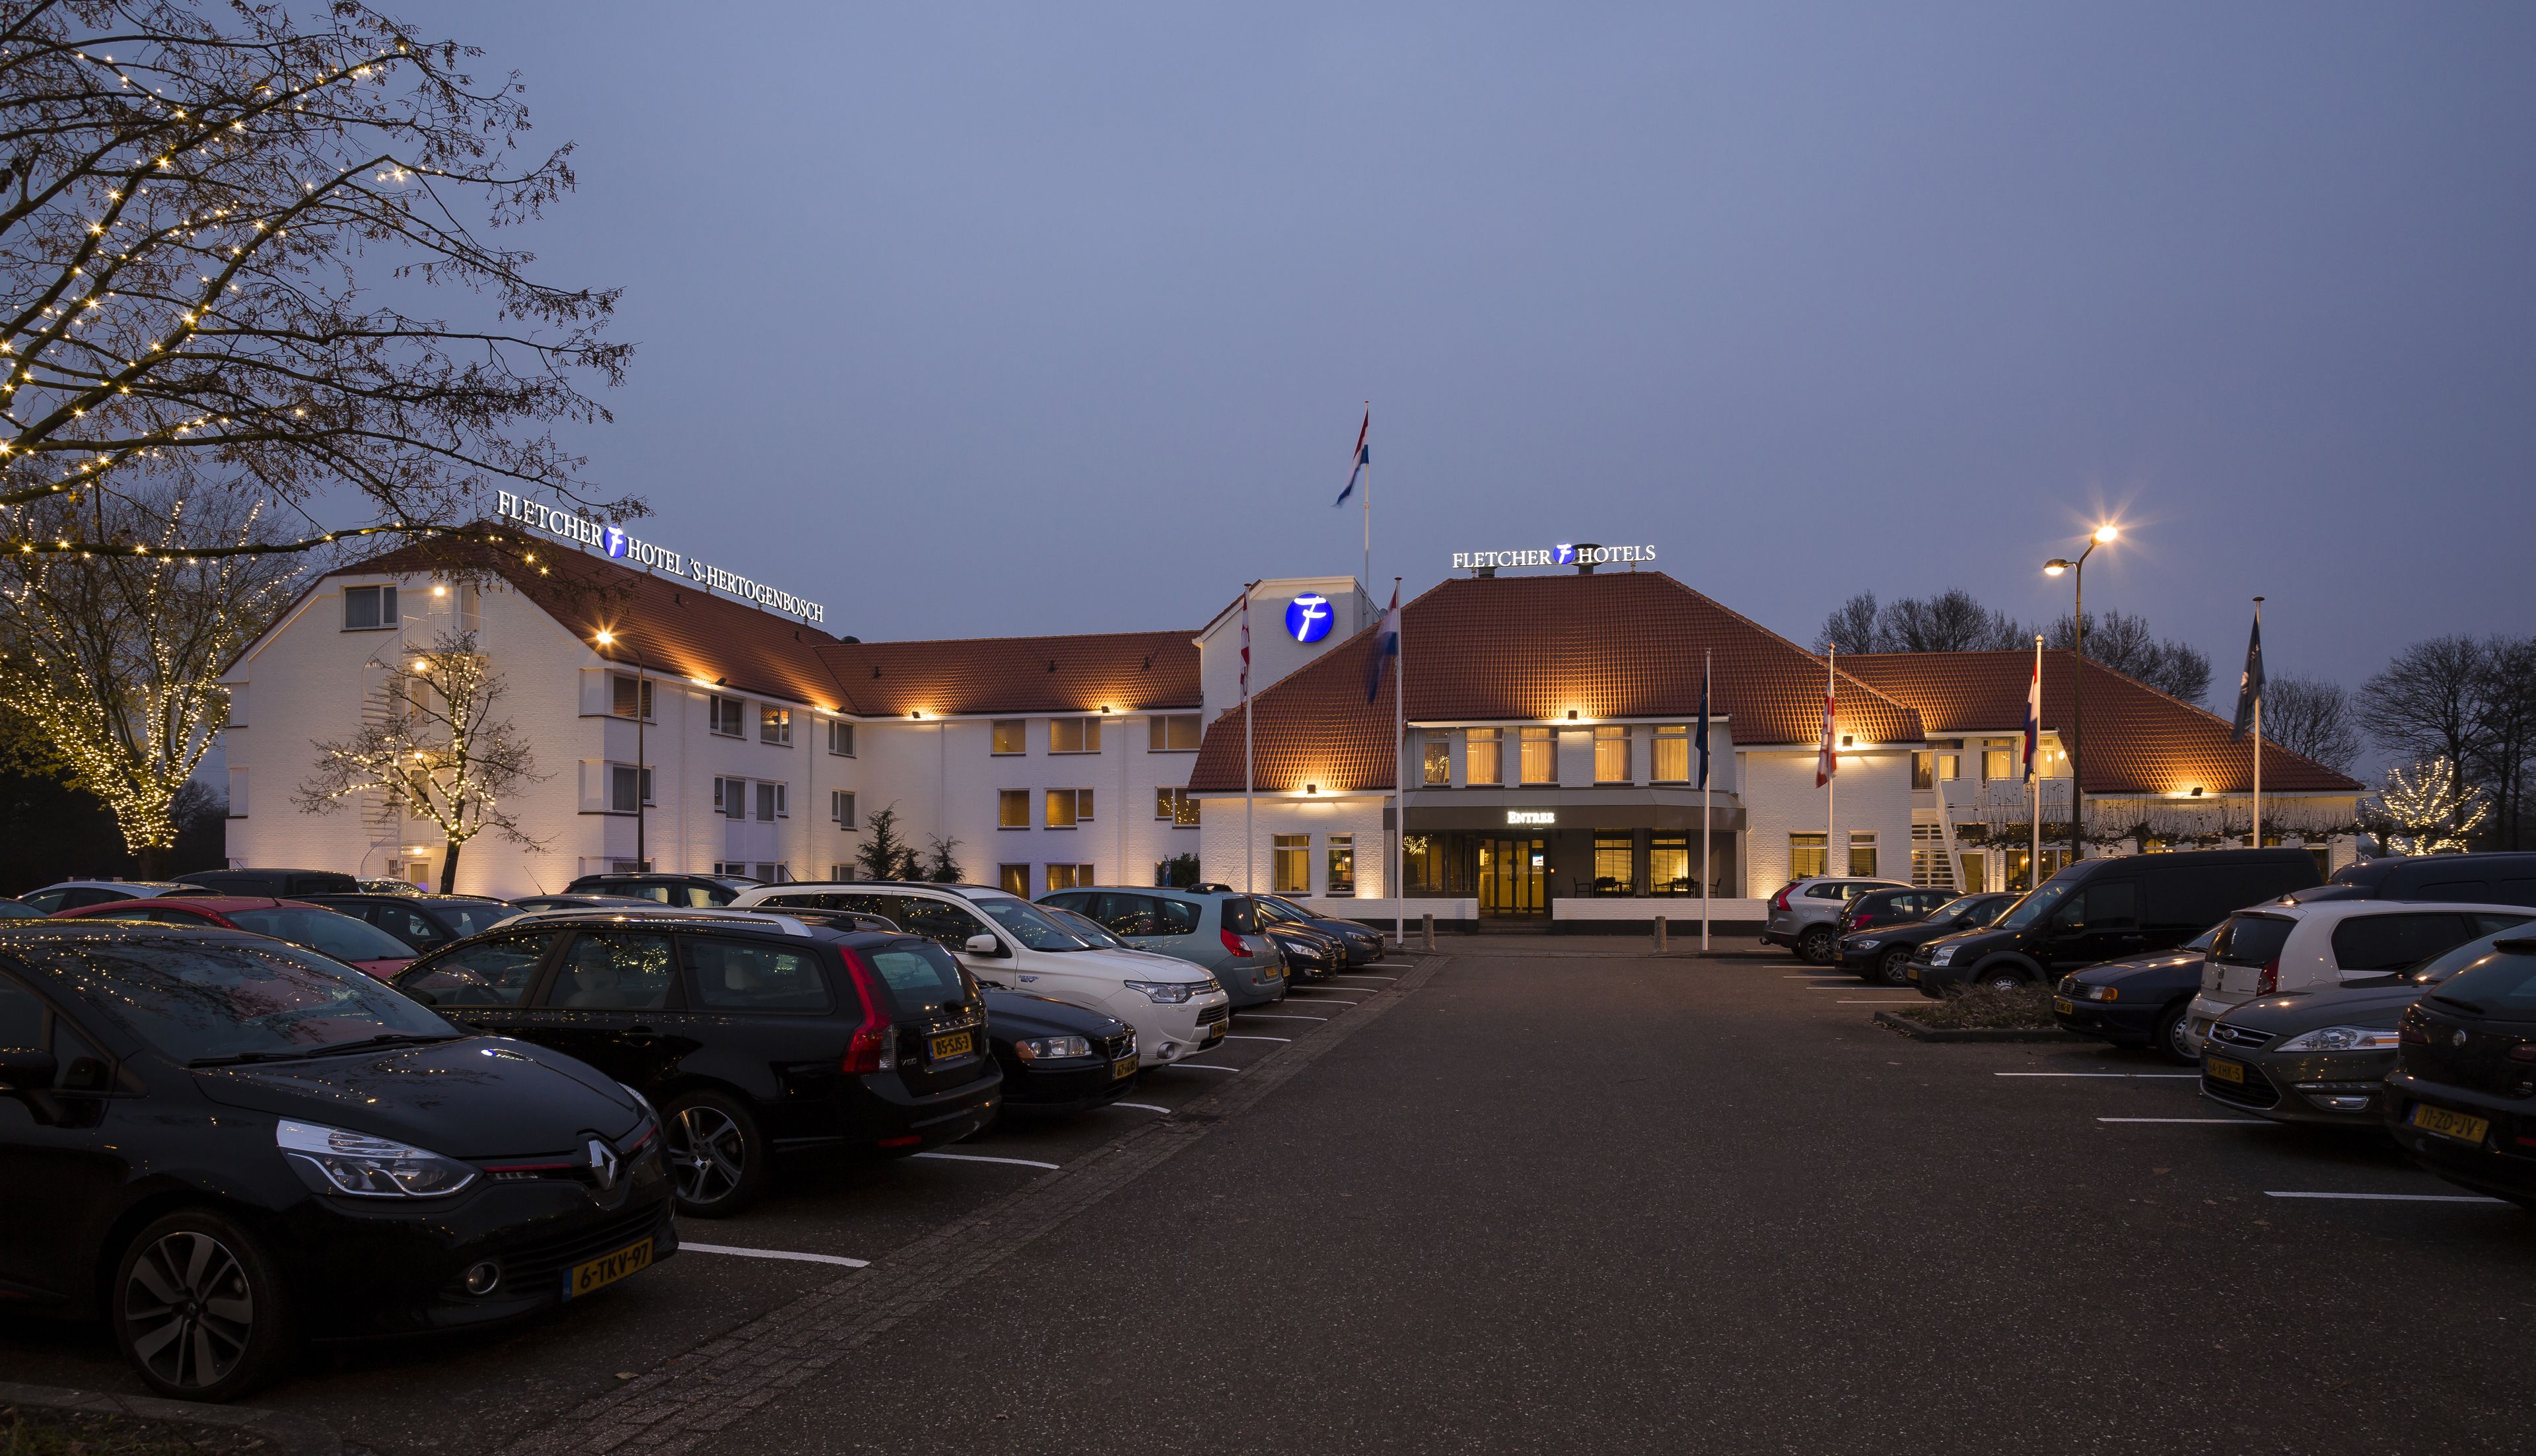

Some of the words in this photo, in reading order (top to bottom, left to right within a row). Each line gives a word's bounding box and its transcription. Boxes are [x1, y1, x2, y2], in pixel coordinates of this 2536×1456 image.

[497, 490, 604, 548] FLETCHER
[627, 536, 684, 576] HOTEL
[689, 558, 824, 622] 'S-HERTOGENBOSCH
[1452, 550, 1552, 568] FLETCHER
[1578, 545, 1656, 563] HOTELS
[1507, 811, 1555, 824] ENTREE
[935, 1035, 969, 1056] 85-SJS-3
[2421, 1109, 2478, 1136] 11-ZD-JV
[581, 1242, 649, 1290] 6-TKV-97
